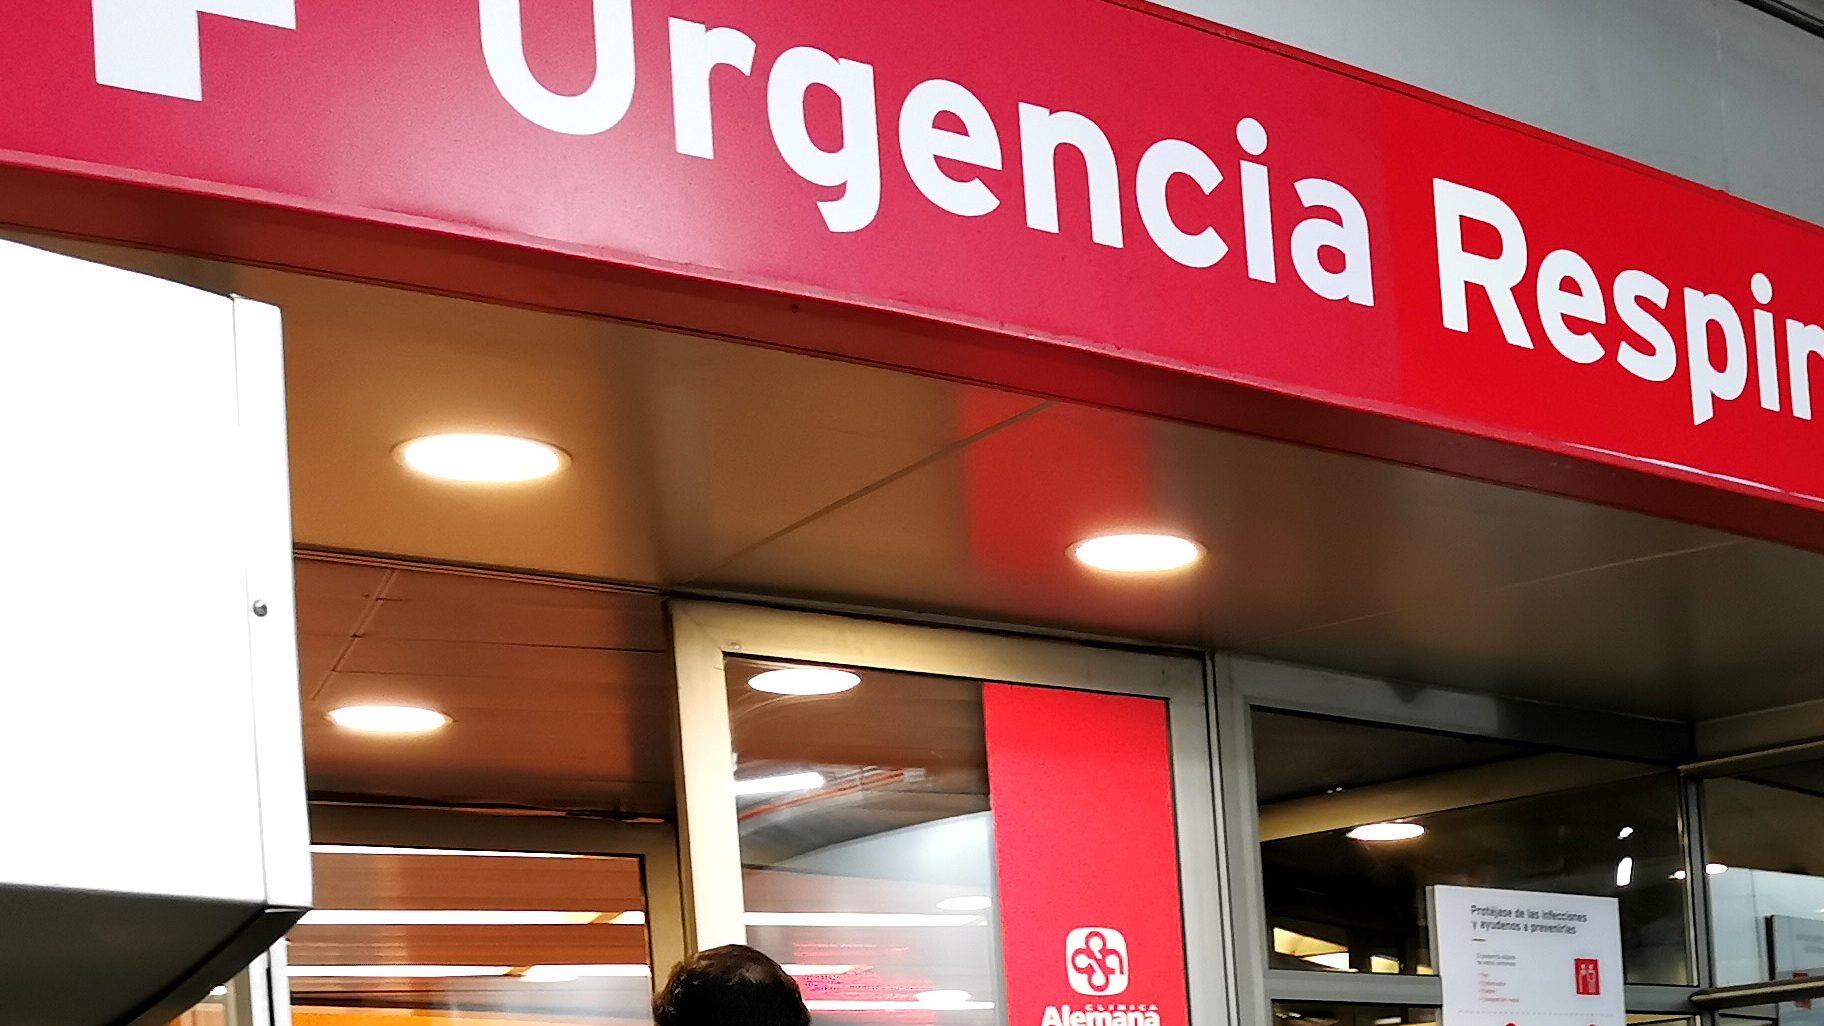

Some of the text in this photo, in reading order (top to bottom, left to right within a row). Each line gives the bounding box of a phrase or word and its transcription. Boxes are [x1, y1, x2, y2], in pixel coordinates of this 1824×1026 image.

[479, 0, 1376, 308] Urgencia
[1515, 908, 1525, 919] de
[1527, 909, 1540, 920] las
[1542, 910, 1588, 923] infecciones
